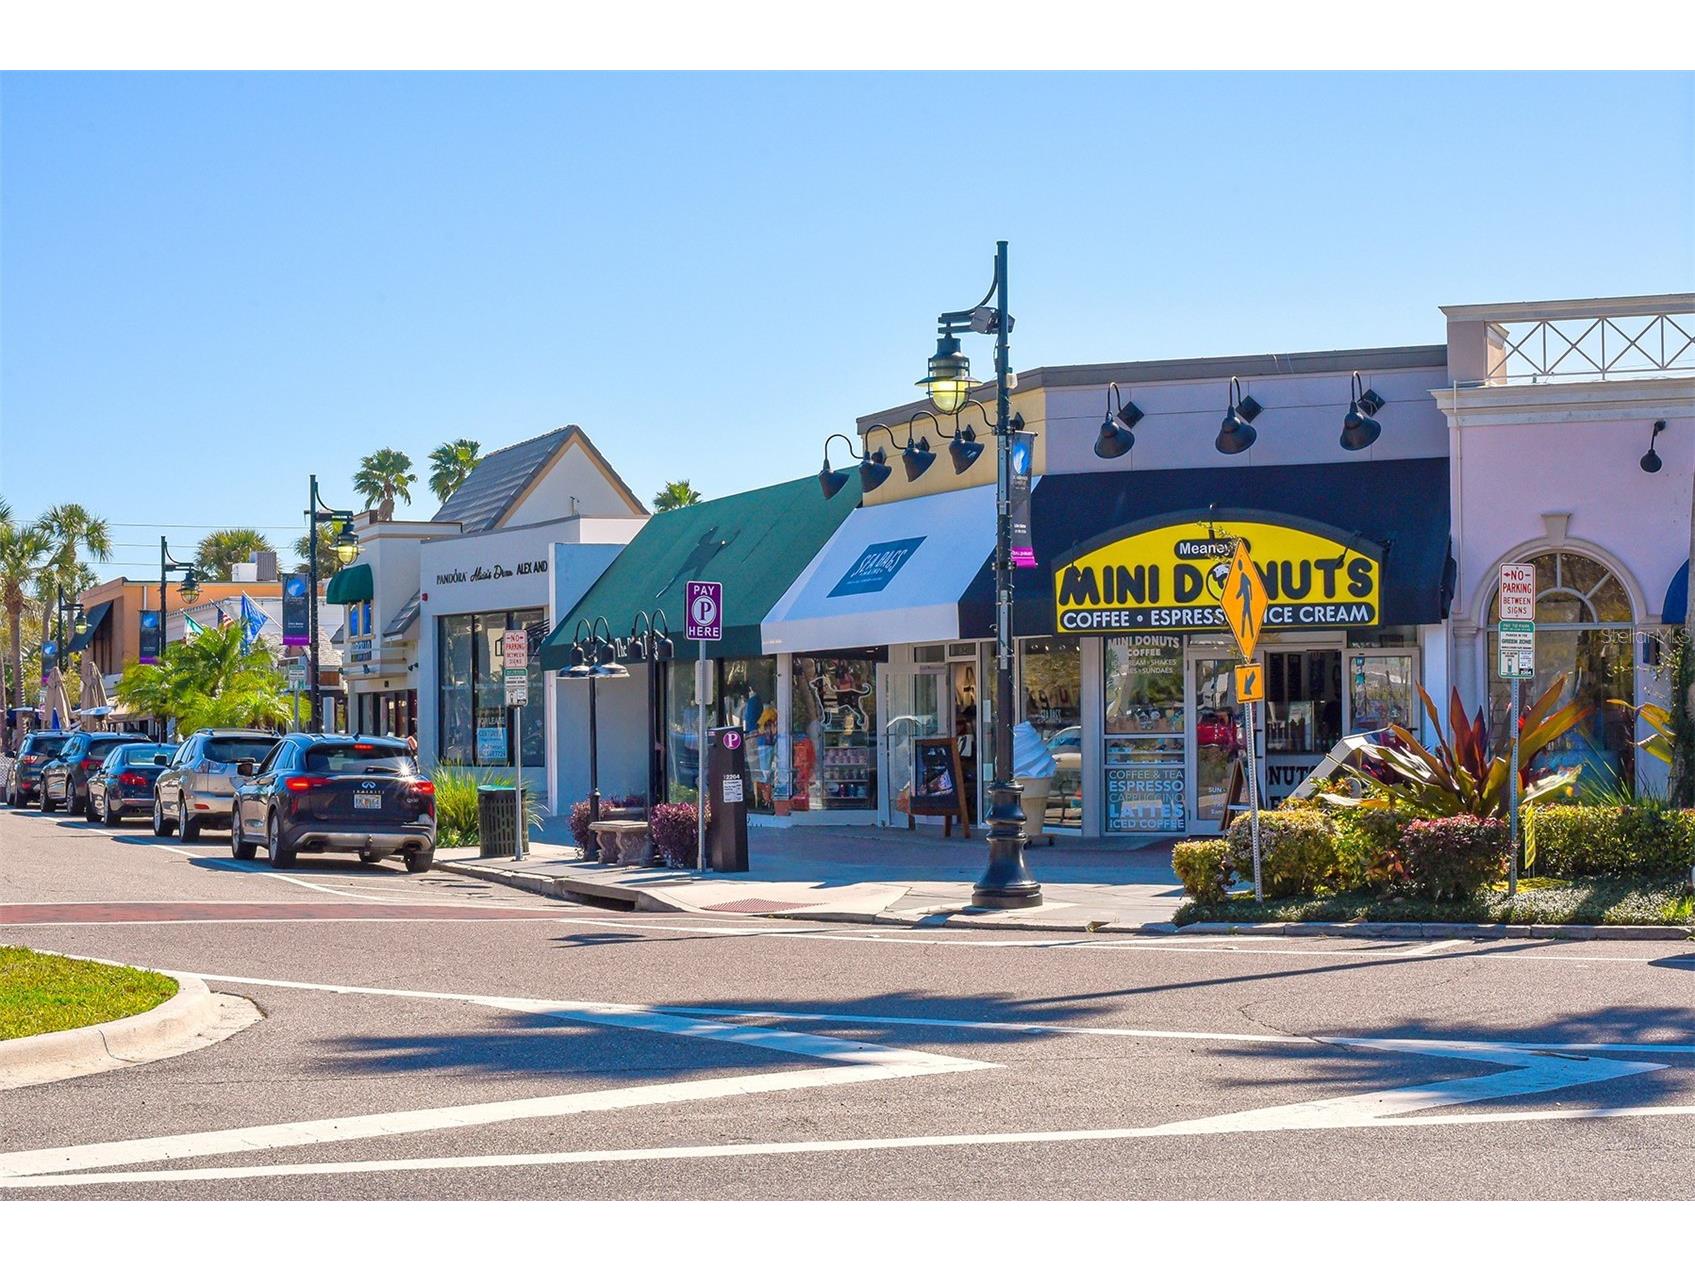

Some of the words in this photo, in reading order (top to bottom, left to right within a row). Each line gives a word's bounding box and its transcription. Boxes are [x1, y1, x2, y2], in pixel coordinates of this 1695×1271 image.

[516, 562, 533, 576] ALEX
[1510, 570, 1524, 581] NO
[693, 585, 715, 595] PAY
[1058, 564, 1160, 605] MINI
[1502, 583, 1532, 593] PARKING
[1503, 596, 1531, 604] BETWEEN
[699, 601, 712, 620] P
[1507, 606, 1527, 614] SIGNS
[1063, 610, 1130, 628] COFFEE
[1150, 608, 1227, 626] ESPRESS
[1264, 607, 1293, 623] ICE
[1299, 605, 1369, 622] CREAM
[688, 626, 719, 637] HERE
[1107, 636, 1133, 649] MINI
[1135, 635, 1180, 648] DONUTS
[1127, 648, 1161, 657] COFFEE
[727, 733, 739, 747] P
[1109, 770, 1151, 779] COFFEE
[1152, 770, 1161, 779] &
[1163, 770, 1184, 779] TEA
[1109, 780, 1184, 792] ESPRESSO
[1109, 793, 1184, 803] CAPPUCCINO
[1109, 804, 1184, 818] LATTES
[1109, 819, 1136, 828] ICED
[1139, 819, 1184, 828] COFFEE
